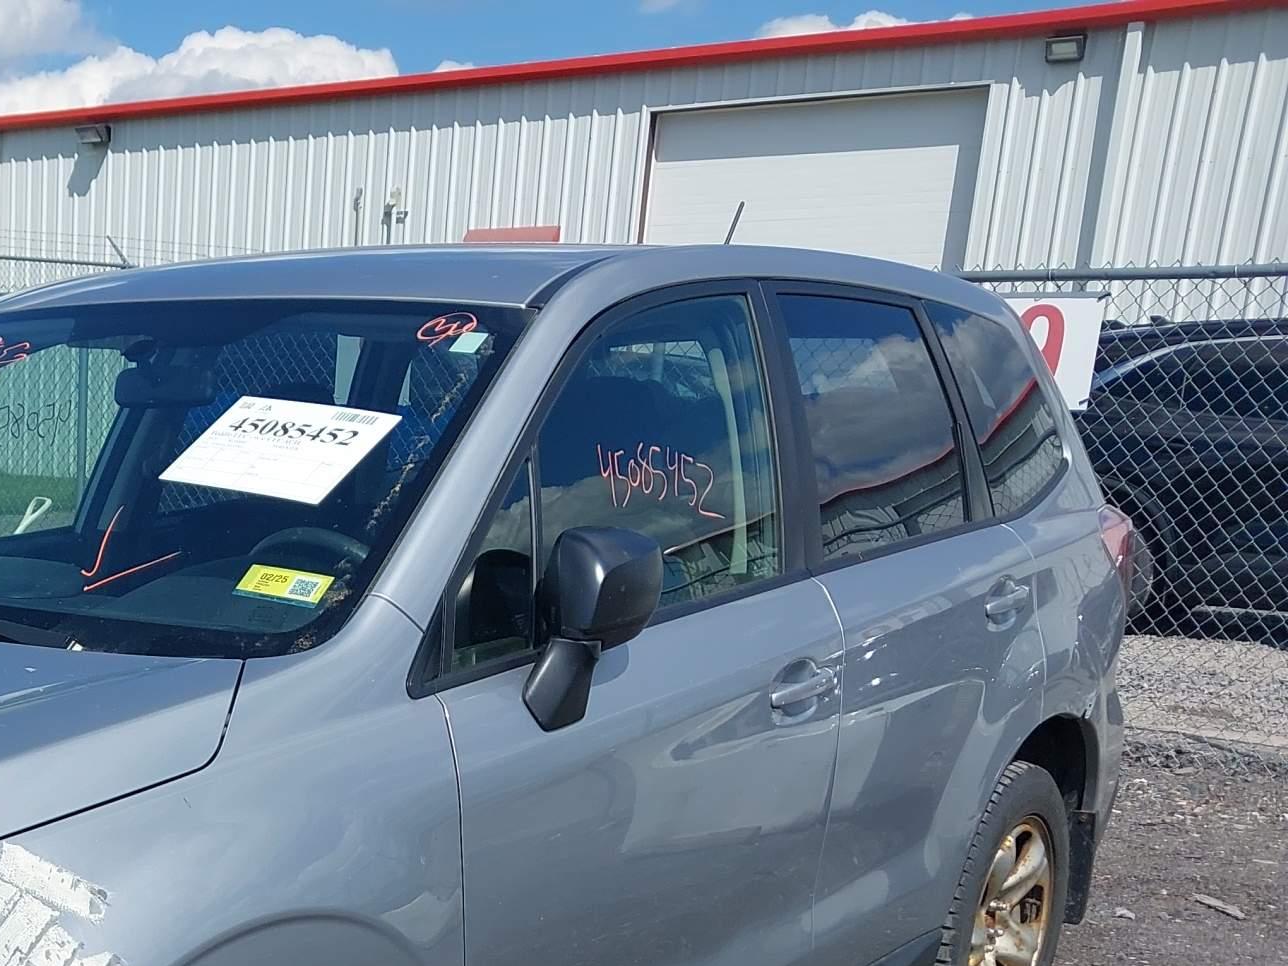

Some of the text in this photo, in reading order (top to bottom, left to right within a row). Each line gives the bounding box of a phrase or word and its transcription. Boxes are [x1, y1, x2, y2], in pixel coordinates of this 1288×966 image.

[229, 416, 360, 447] 45085452
[597, 441, 726, 519] 45085452
[260, 572, 290, 584] 02/25
